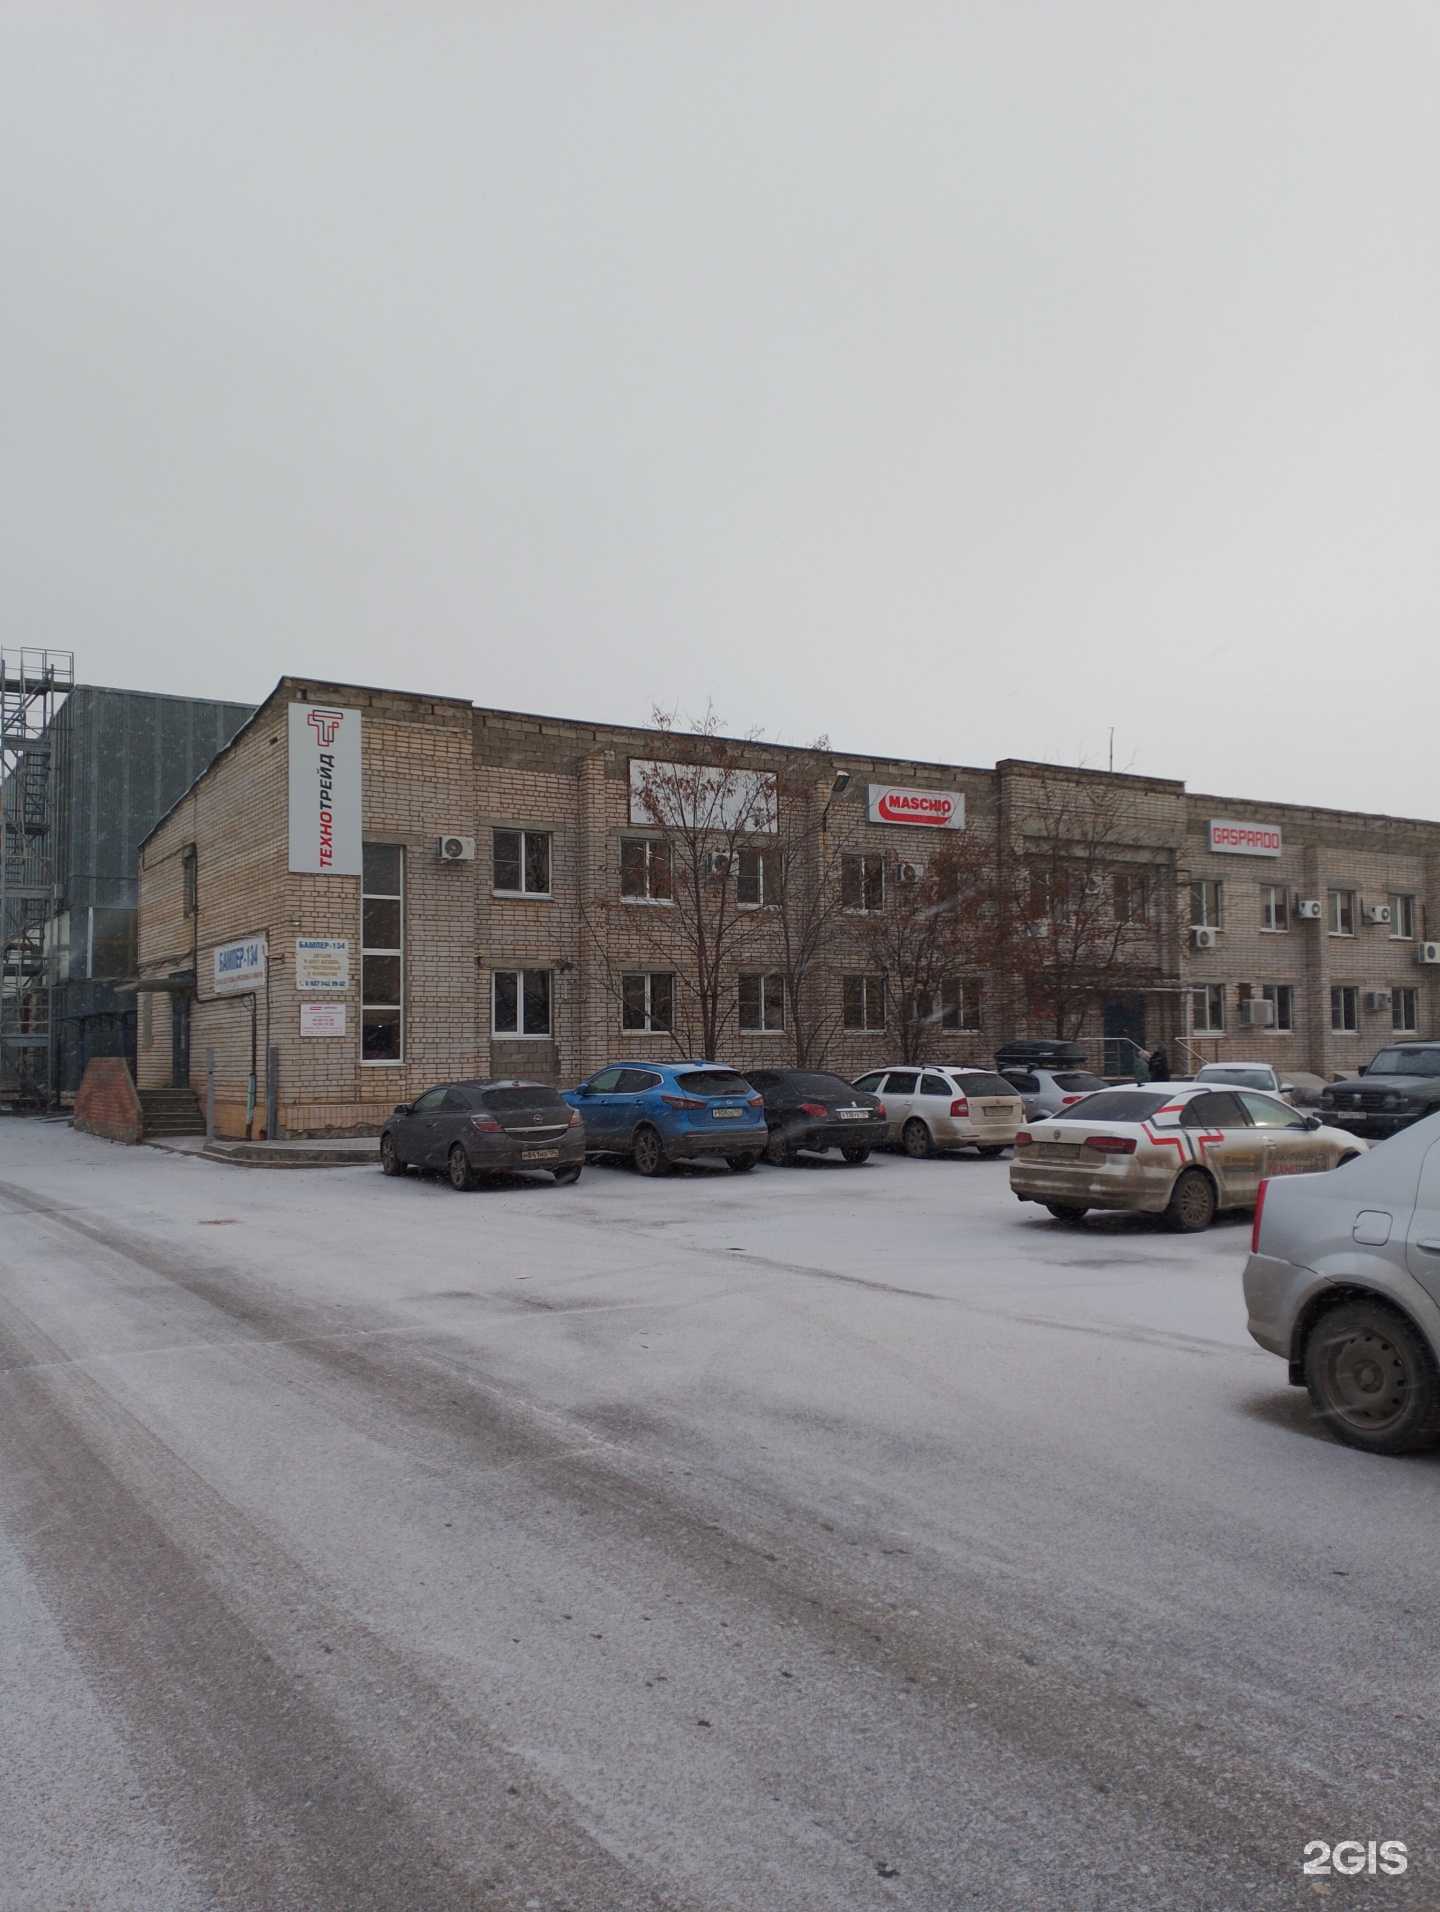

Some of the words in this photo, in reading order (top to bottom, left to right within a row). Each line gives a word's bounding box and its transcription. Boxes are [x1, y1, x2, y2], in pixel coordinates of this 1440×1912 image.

[317, 753, 335, 868] ТЕХНОТРЕЙД
[889, 795, 952, 813] MASCHIO
[1213, 827, 1280, 849] GASPARDO
